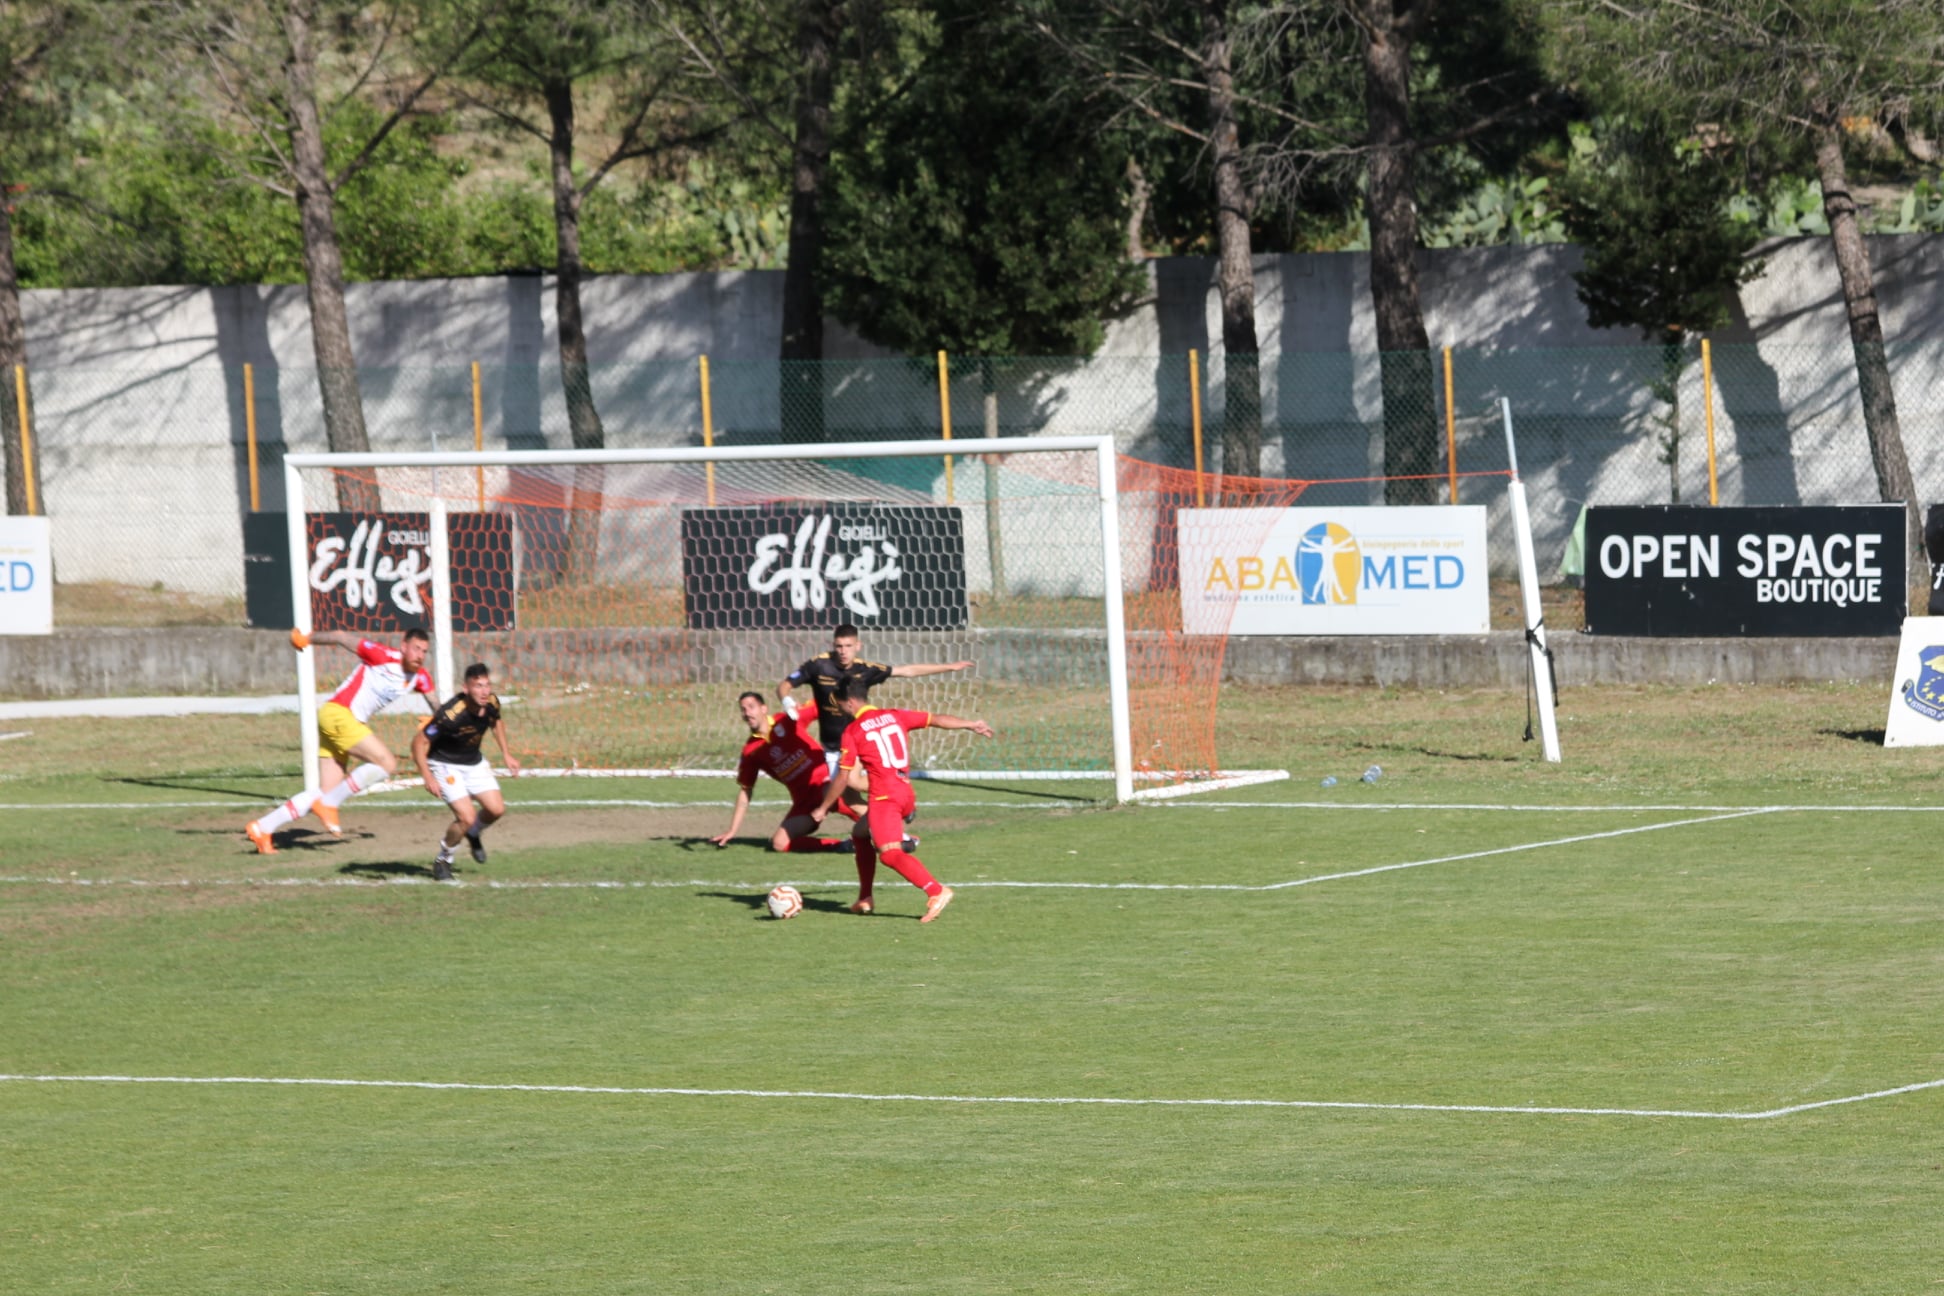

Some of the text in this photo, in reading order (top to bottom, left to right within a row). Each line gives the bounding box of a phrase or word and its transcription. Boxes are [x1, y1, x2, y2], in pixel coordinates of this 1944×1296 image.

[838, 525, 886, 541] GIOIELLI
[0, 561, 34, 592] D
[309, 519, 432, 615] Effeg
[748, 514, 902, 617] Effegi
[1204, 555, 1465, 590] ABA MED
[1599, 535, 1720, 579] OPEN
[1736, 534, 1882, 579] SPACE
[1757, 578, 1882, 608] BOUTIQUE
[865, 724, 908, 769] 10
